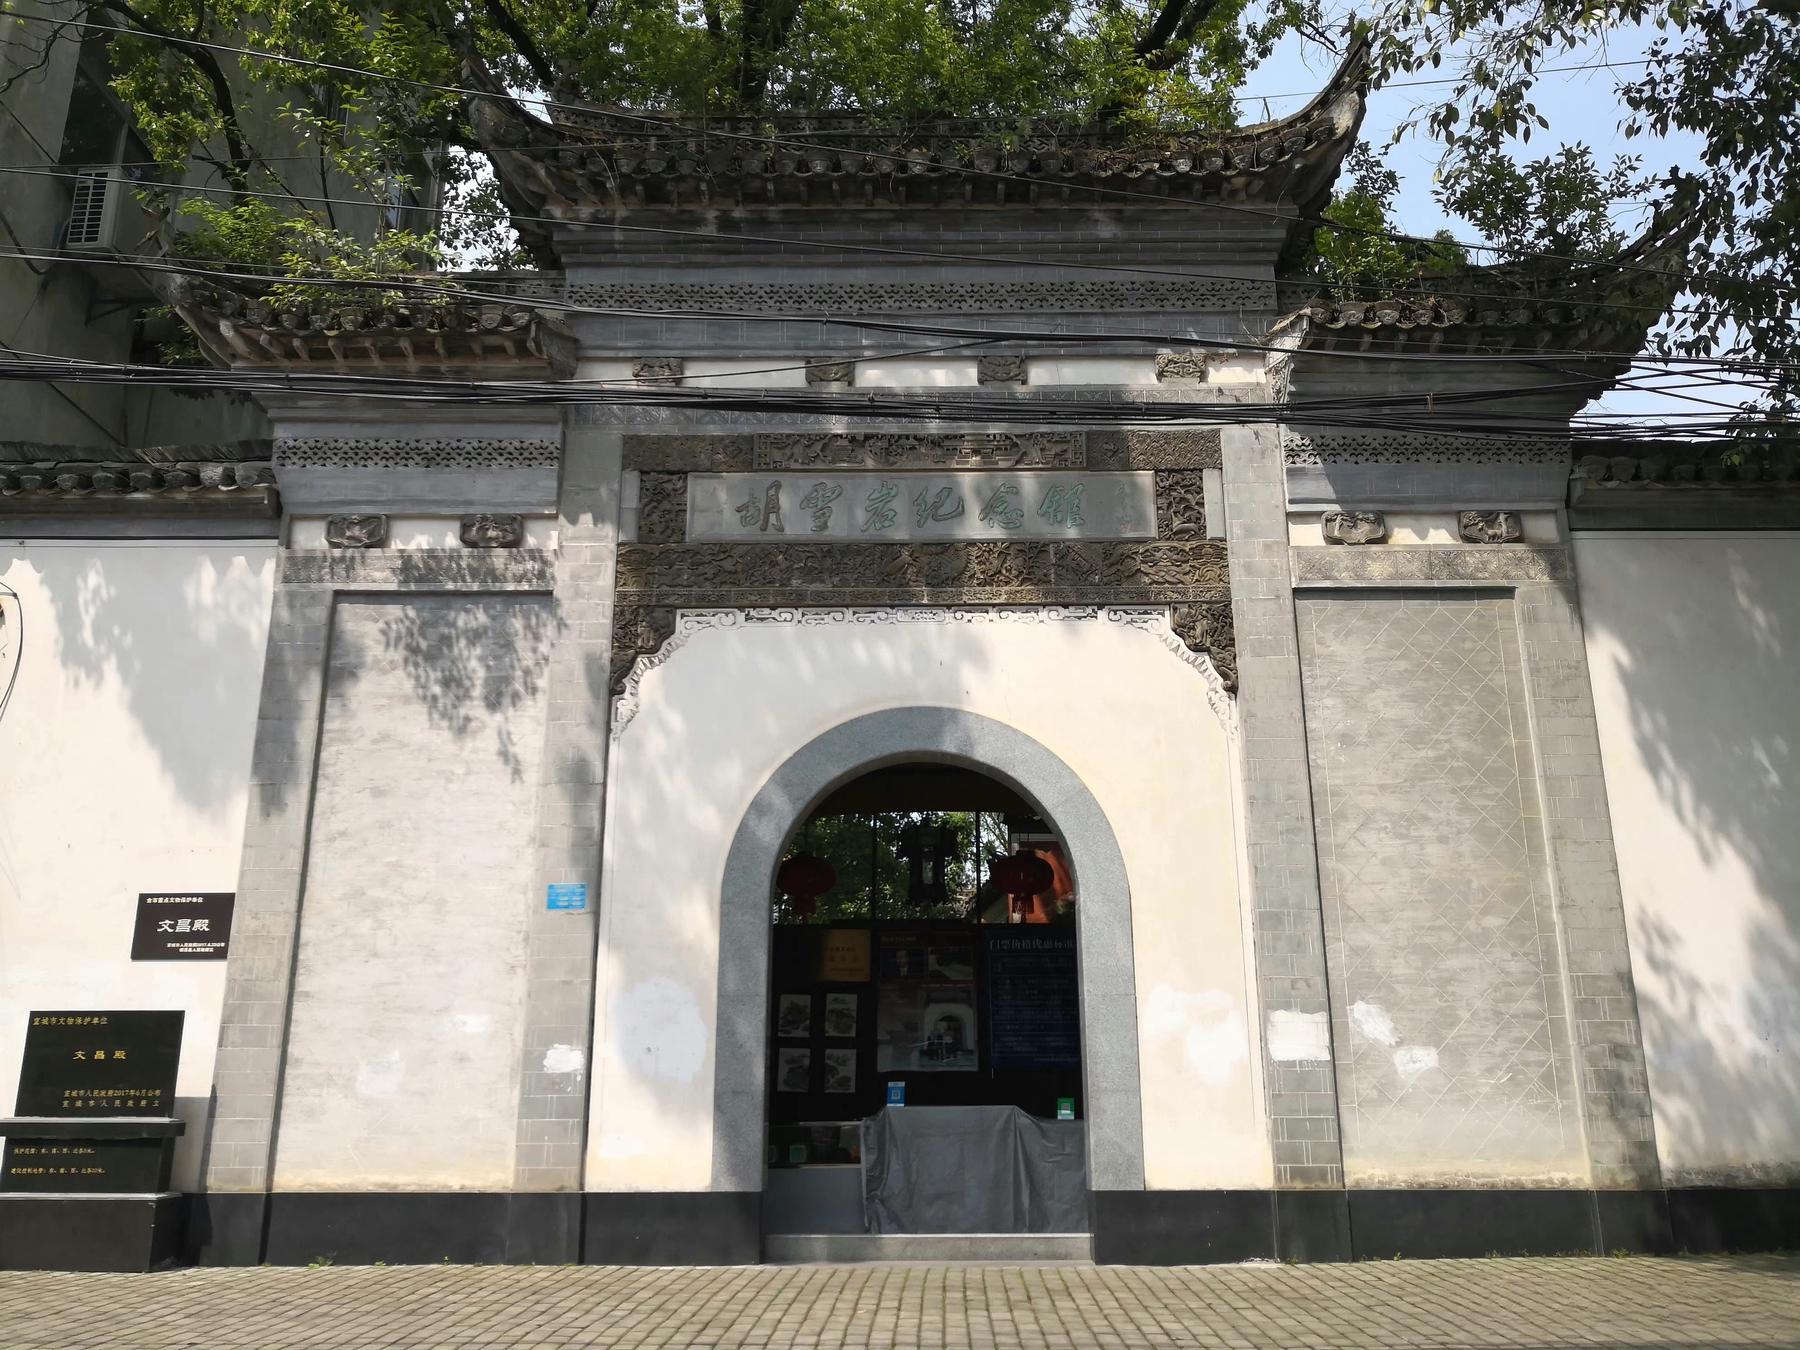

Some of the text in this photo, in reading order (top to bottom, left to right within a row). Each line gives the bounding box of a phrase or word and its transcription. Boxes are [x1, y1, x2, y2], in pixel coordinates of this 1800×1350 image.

[156, 918, 210, 933] 文昌殿
[32, 1016, 109, 1026] 宣城市文物保护单位
[72, 1050, 127, 1060] 文昌殿
